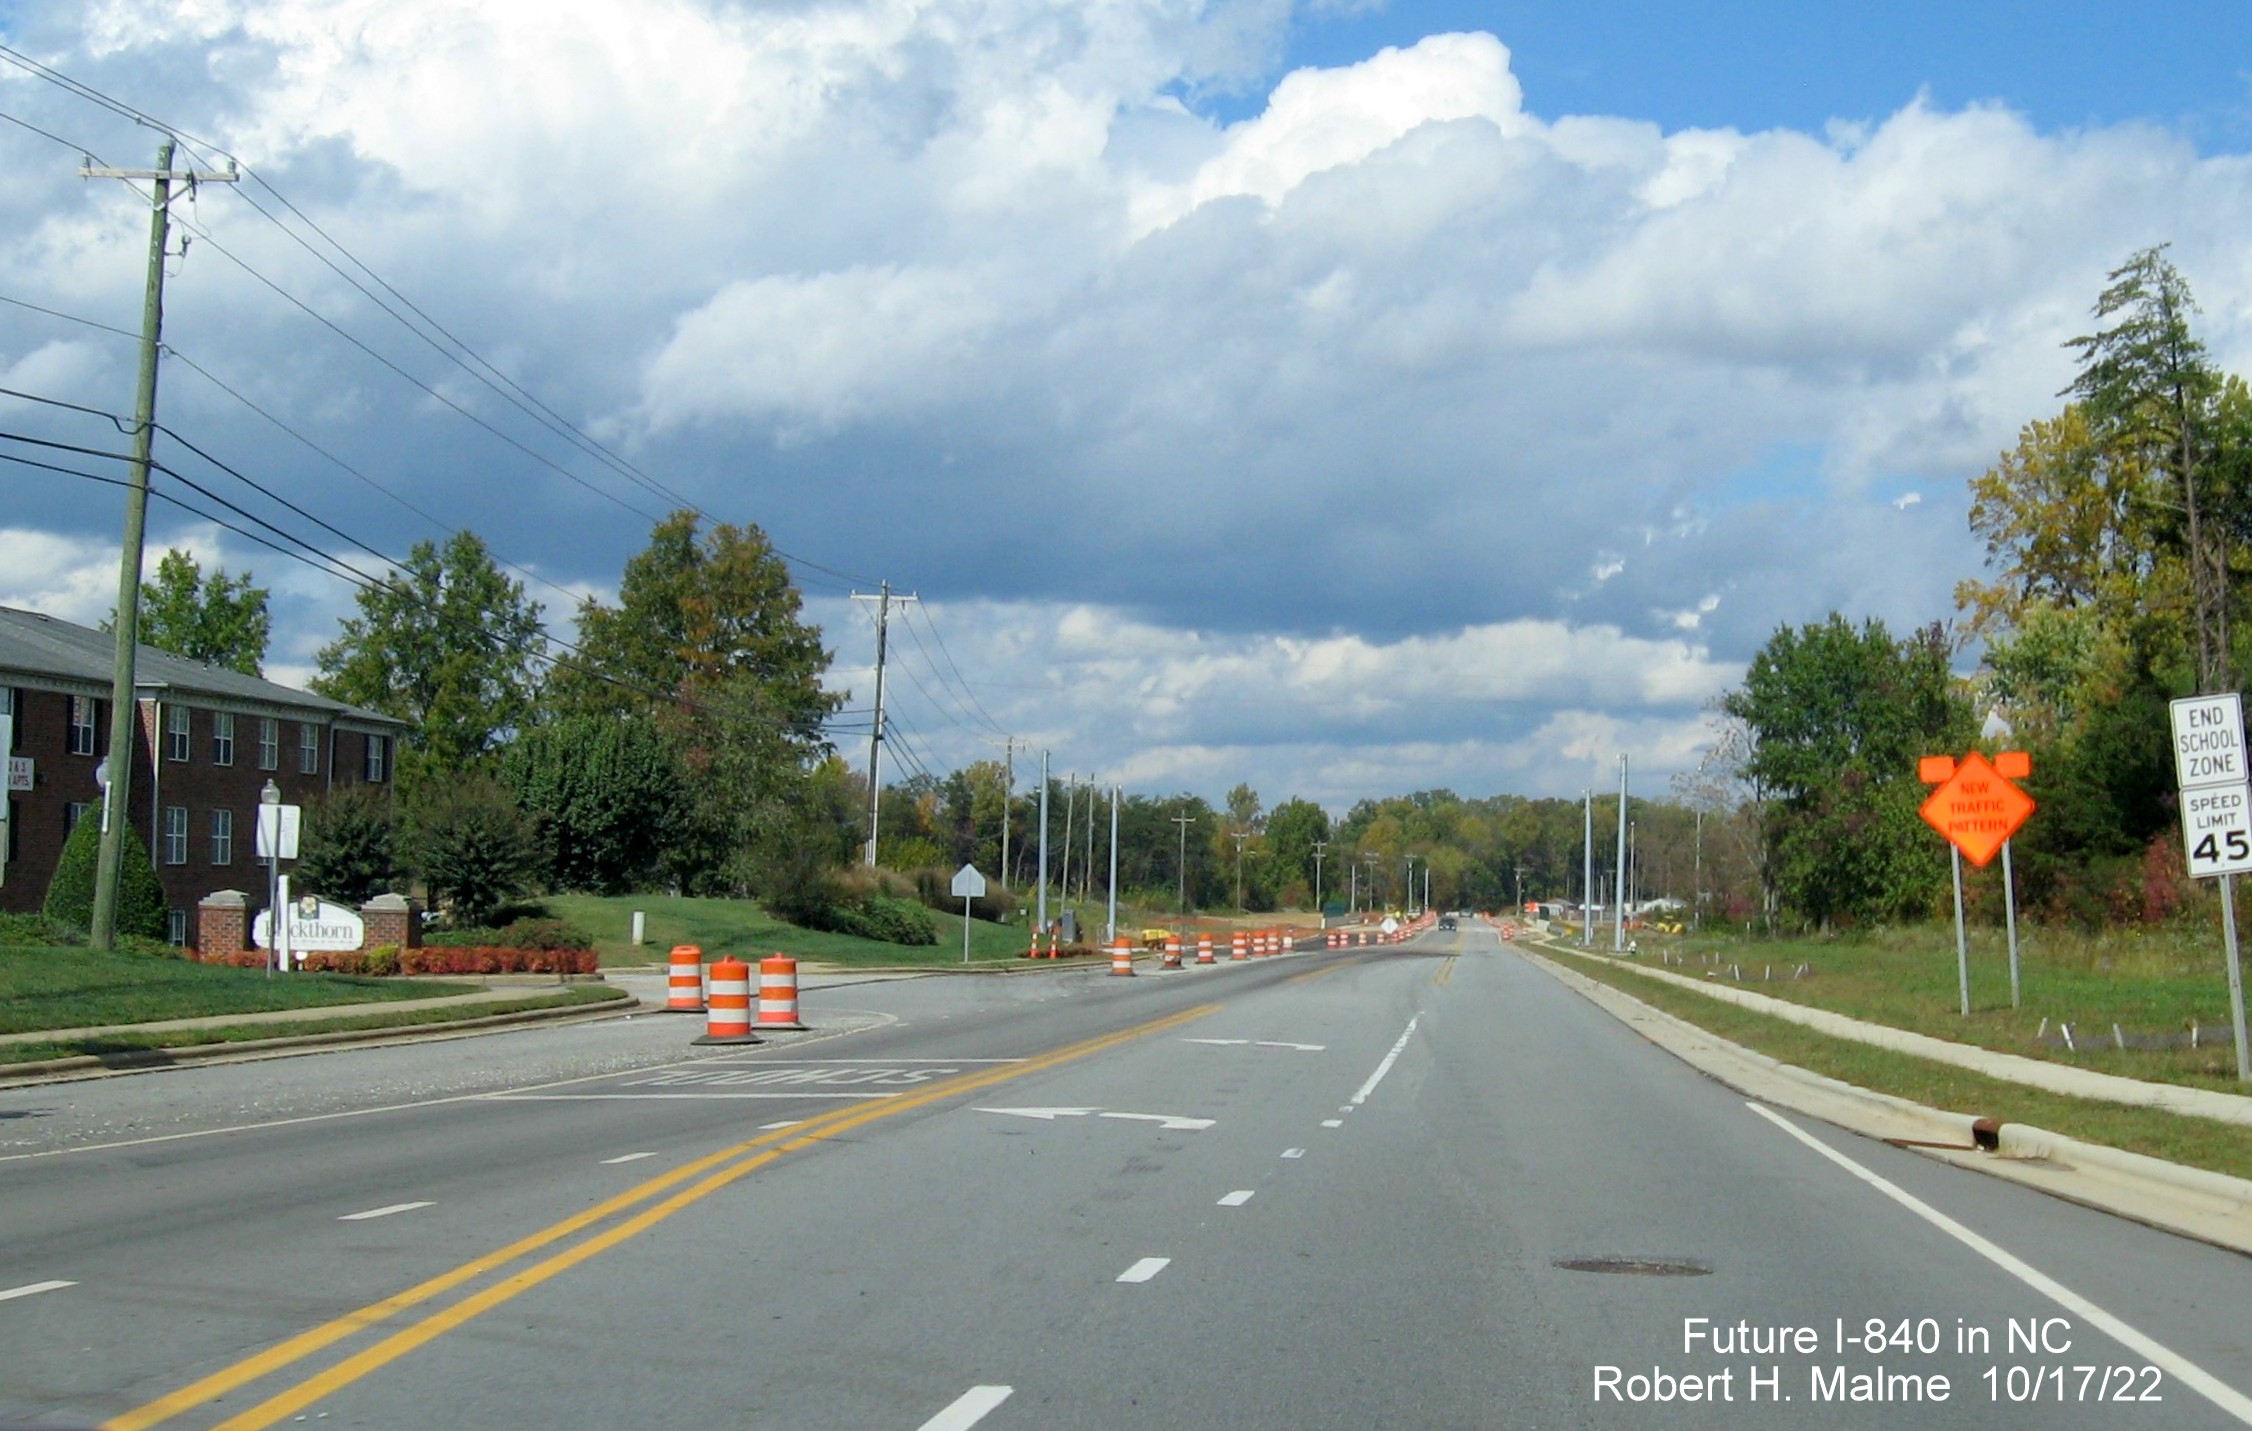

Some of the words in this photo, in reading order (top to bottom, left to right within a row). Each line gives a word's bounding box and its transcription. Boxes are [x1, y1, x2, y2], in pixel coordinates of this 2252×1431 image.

[2189, 706, 2224, 728] END
[2180, 728, 2239, 753] SCHOOL
[2189, 753, 2236, 777] ZONE
[1961, 781, 1989, 795] NEW
[1950, 799, 2005, 815] TRAFFIC
[2190, 794, 2242, 812] SPEED
[1948, 818, 2008, 833] PATTERN
[2196, 812, 2236, 829] LIMIT
[2193, 829, 2250, 863] 45
[264, 920, 353, 939] Bckthorn
[622, 1068, 959, 1087] SCHOOL
